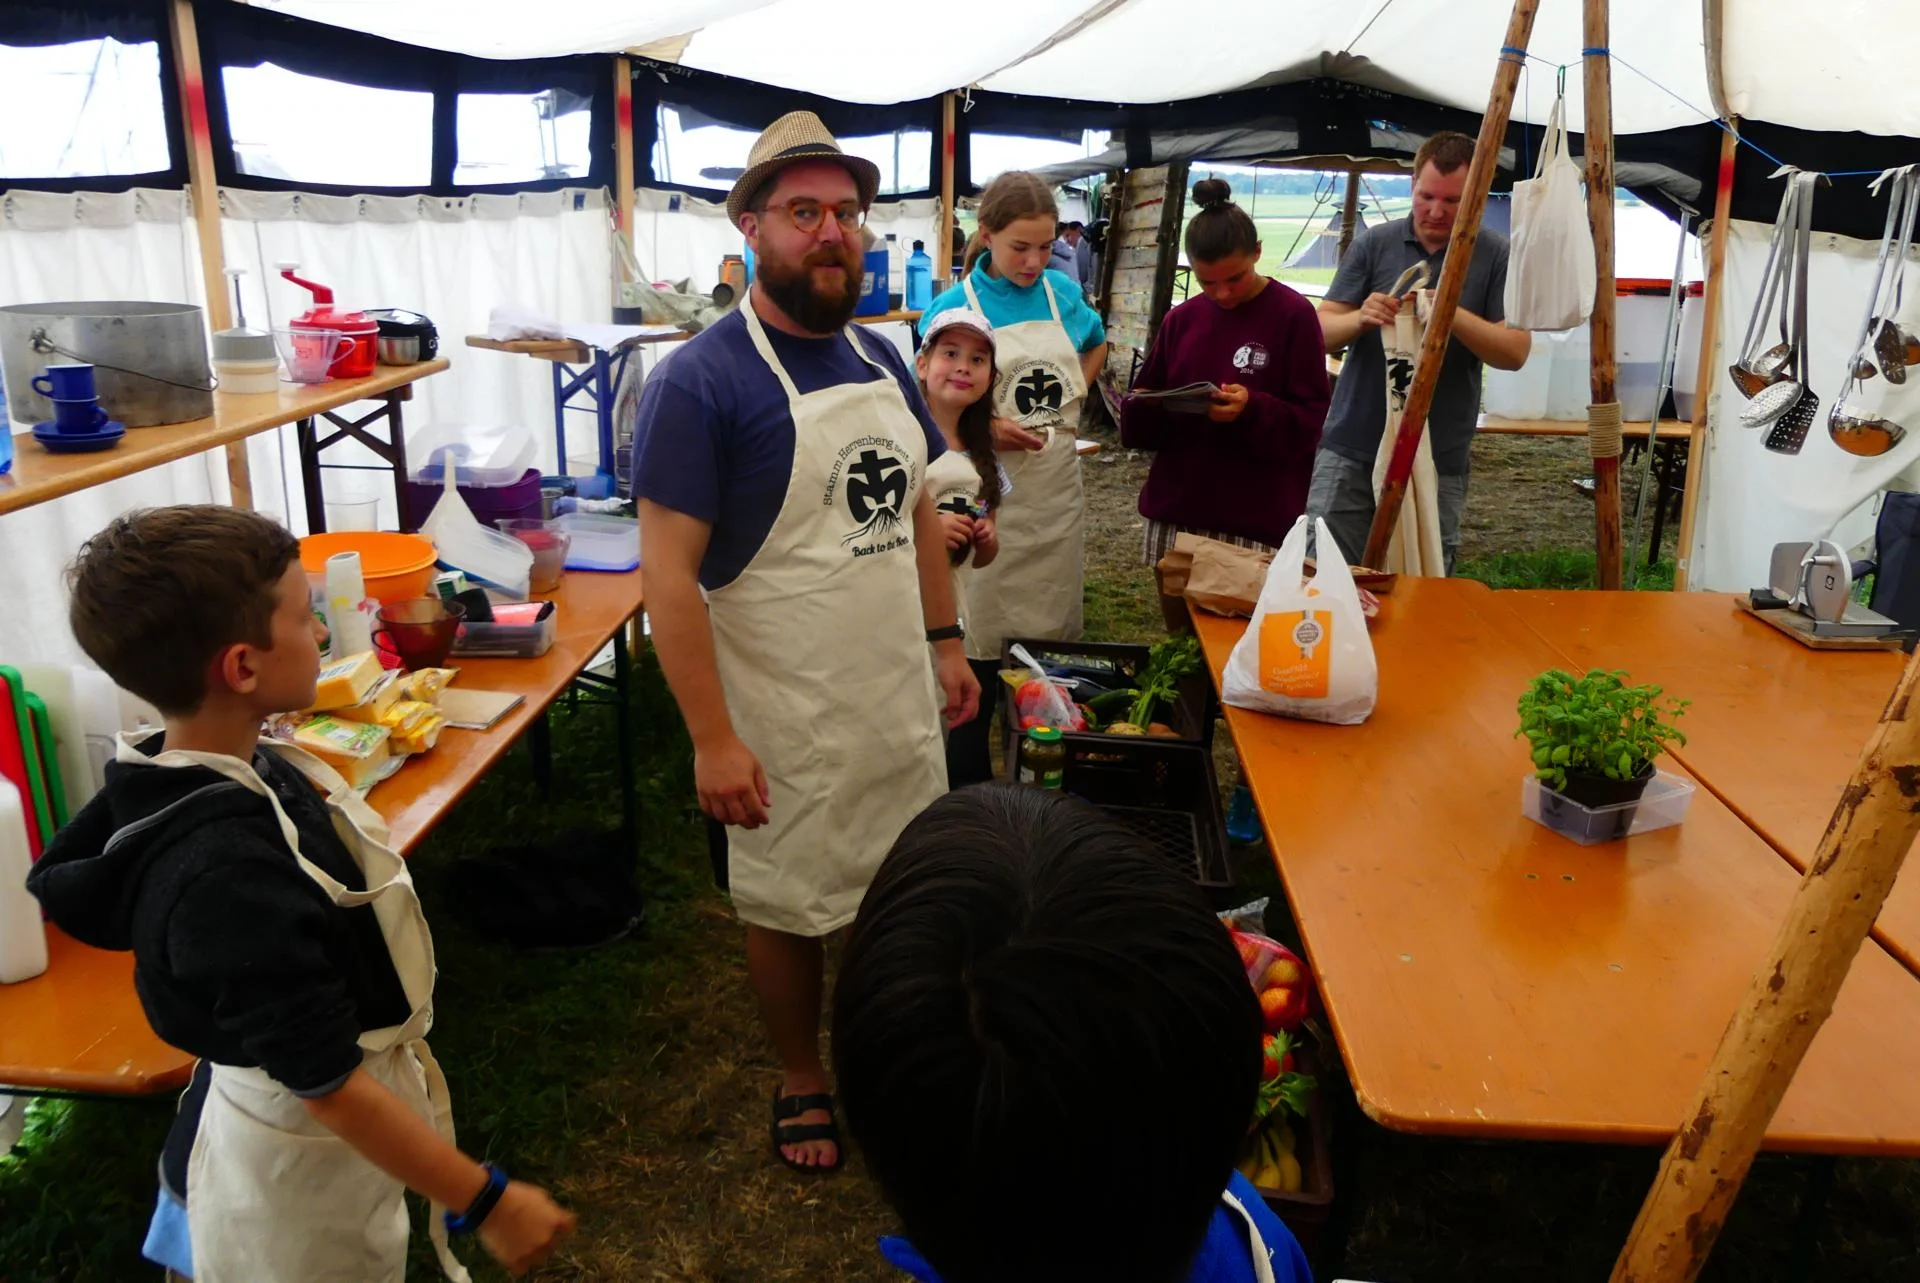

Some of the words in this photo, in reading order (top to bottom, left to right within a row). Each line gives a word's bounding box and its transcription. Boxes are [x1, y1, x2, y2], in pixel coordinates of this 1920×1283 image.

[823, 459, 843, 506] Stamm
[838, 435, 894, 461] Herrenberg
[852, 543, 876, 557] Back
[876, 543, 886, 553] to
